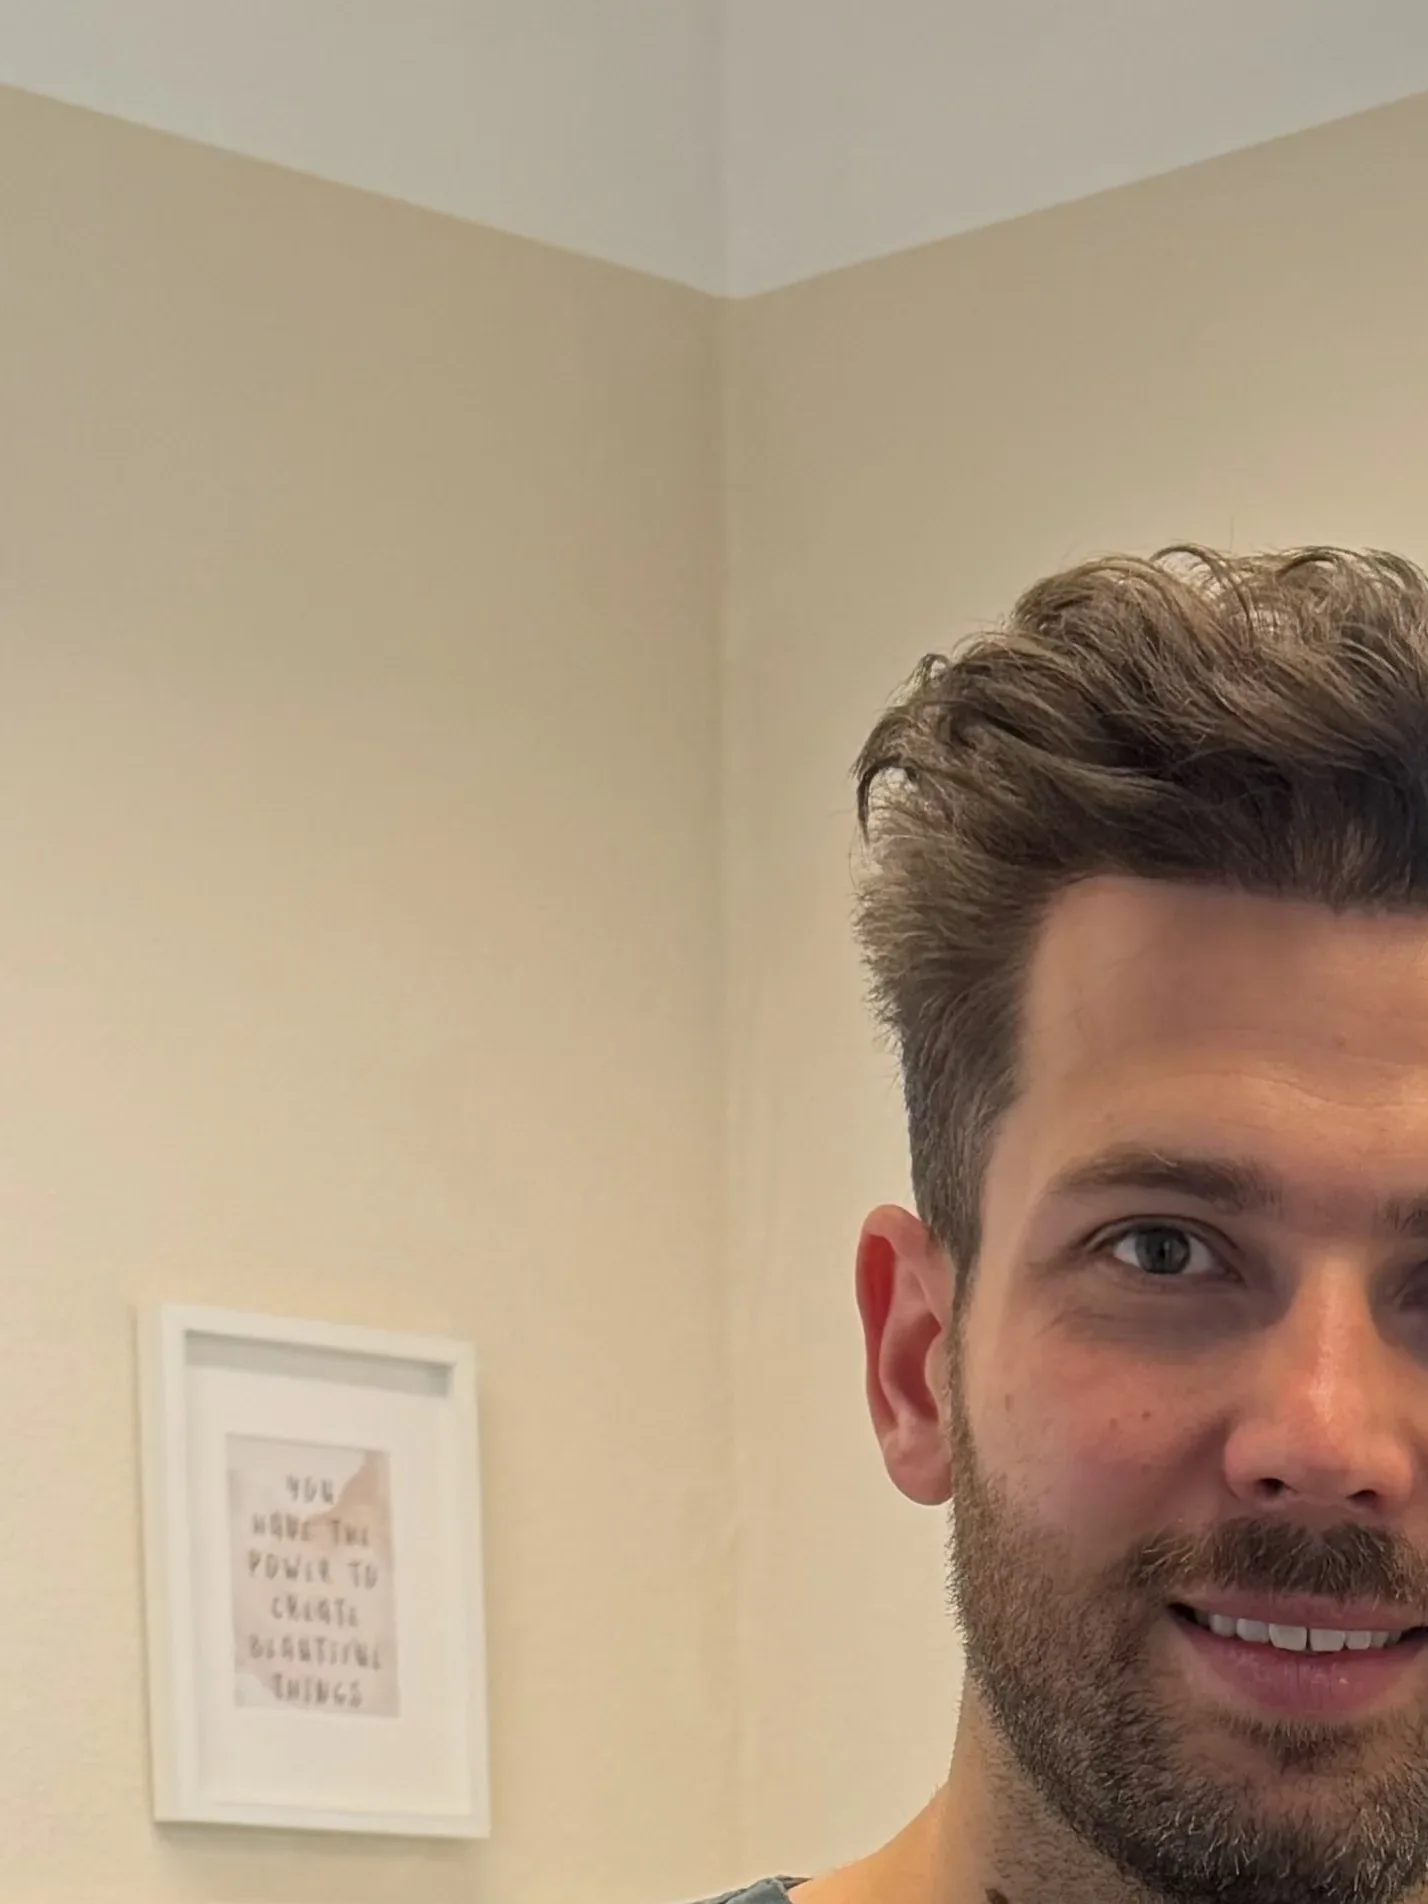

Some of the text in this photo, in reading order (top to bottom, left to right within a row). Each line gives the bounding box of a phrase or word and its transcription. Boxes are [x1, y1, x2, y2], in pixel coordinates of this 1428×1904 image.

[286, 1474, 334, 1504] YOU
[253, 1512, 369, 1547] HAVE THE
[248, 1549, 378, 1590] POWER TO
[271, 1595, 358, 1628] CREATE
[248, 1634, 382, 1671] BEAUTIFUL
[272, 1672, 362, 1708] THINGS
